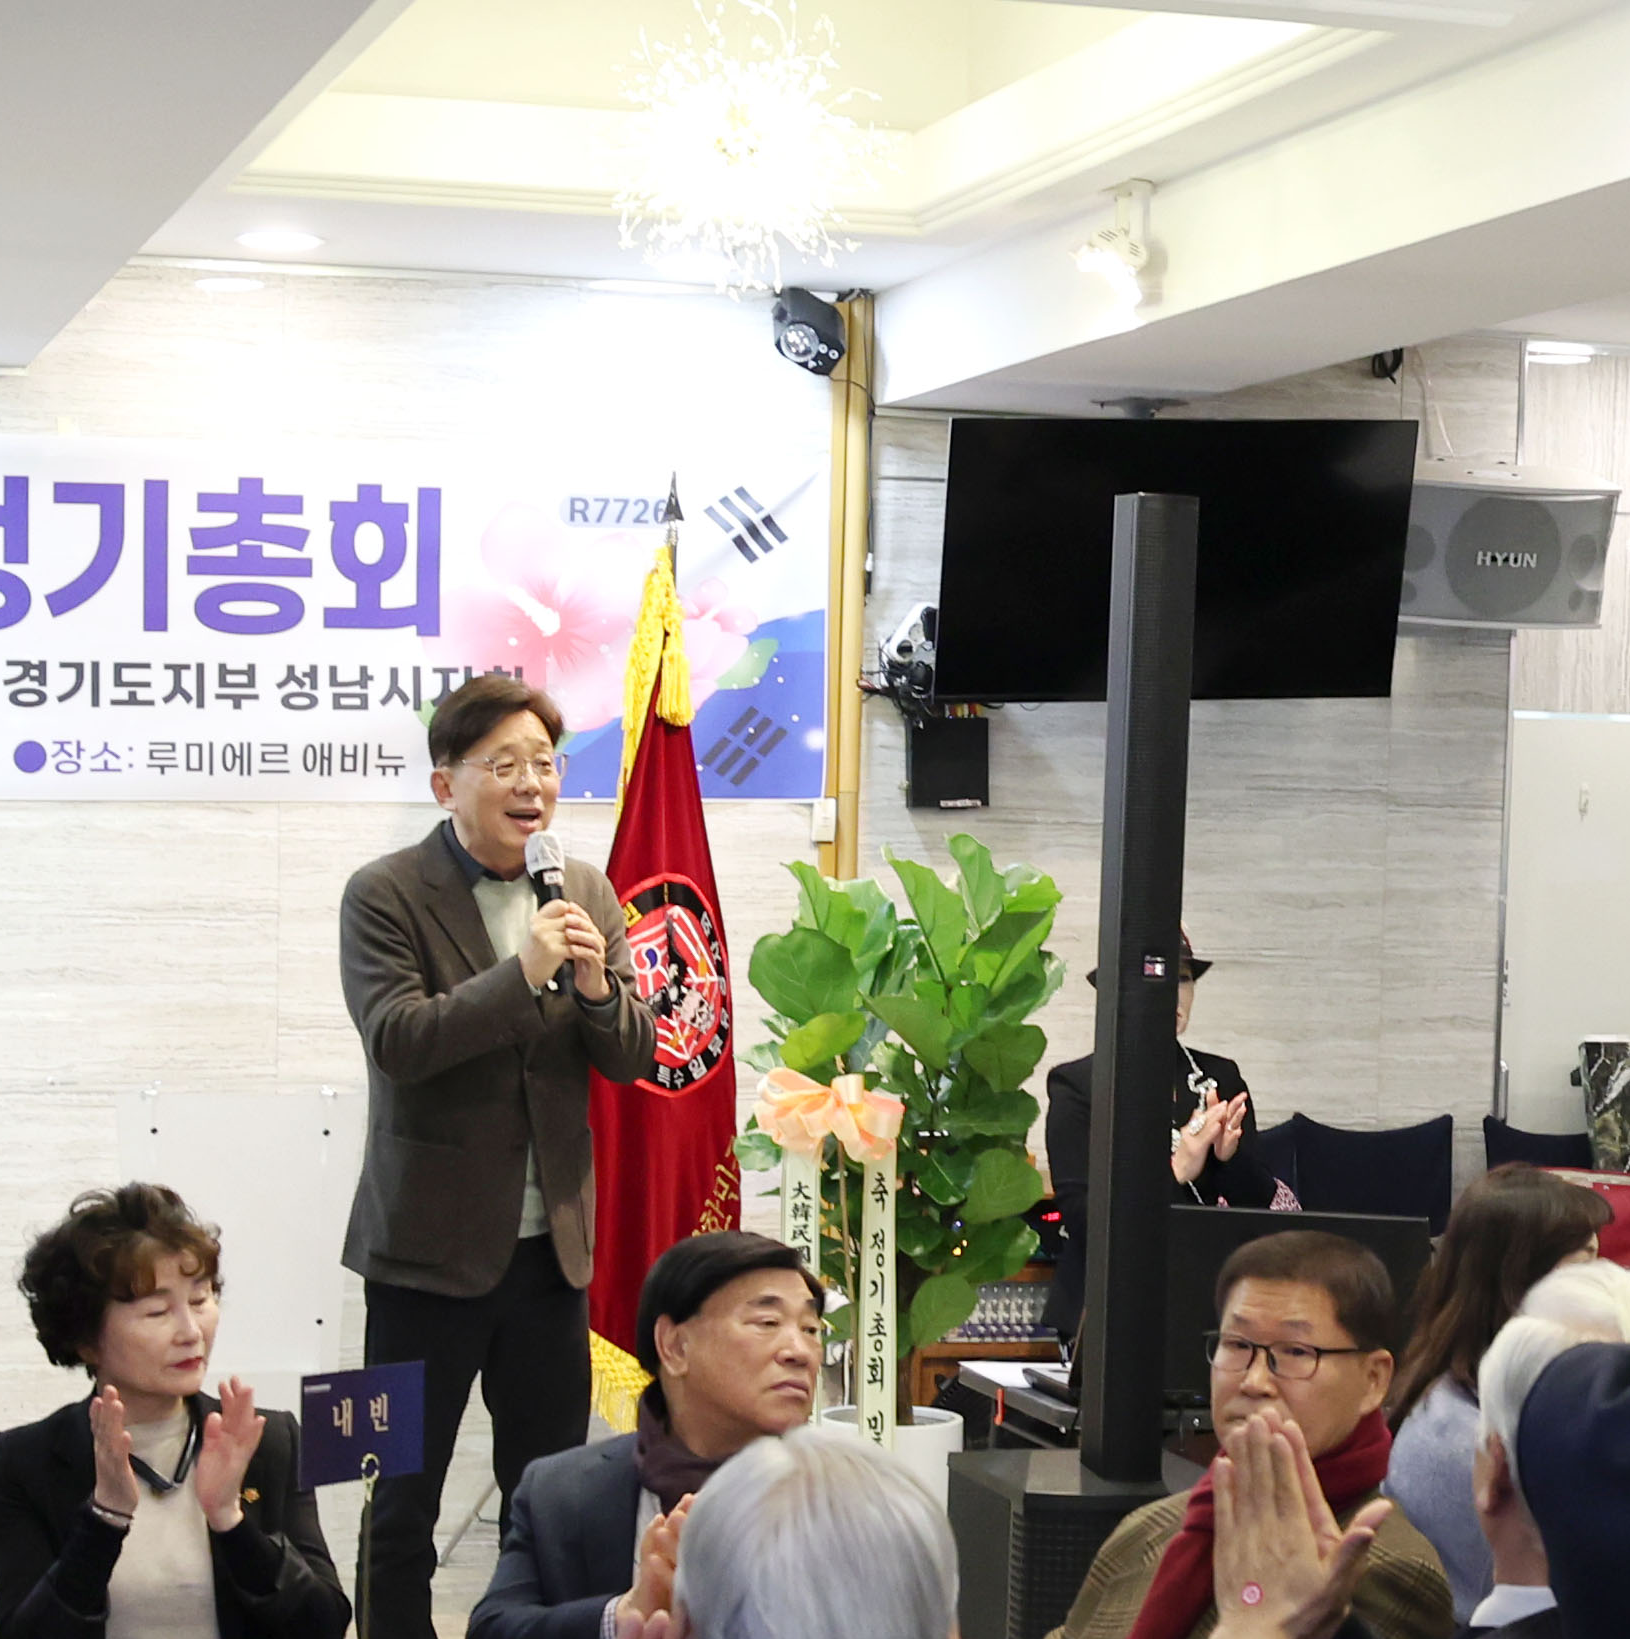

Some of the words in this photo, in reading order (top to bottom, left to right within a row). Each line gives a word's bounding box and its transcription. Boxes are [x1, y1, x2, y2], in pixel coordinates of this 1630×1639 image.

[1476, 550, 1537, 568] HYUN
[2, 659, 260, 711] 경기도지부
[276, 664, 523, 712] 성남시지
[50, 739, 135, 776] 장소:
[146, 740, 291, 777] 루미에르
[302, 741, 407, 777] 애비뉴
[871, 1171, 889, 1213] 축
[866, 1228, 888, 1392] 정기총회
